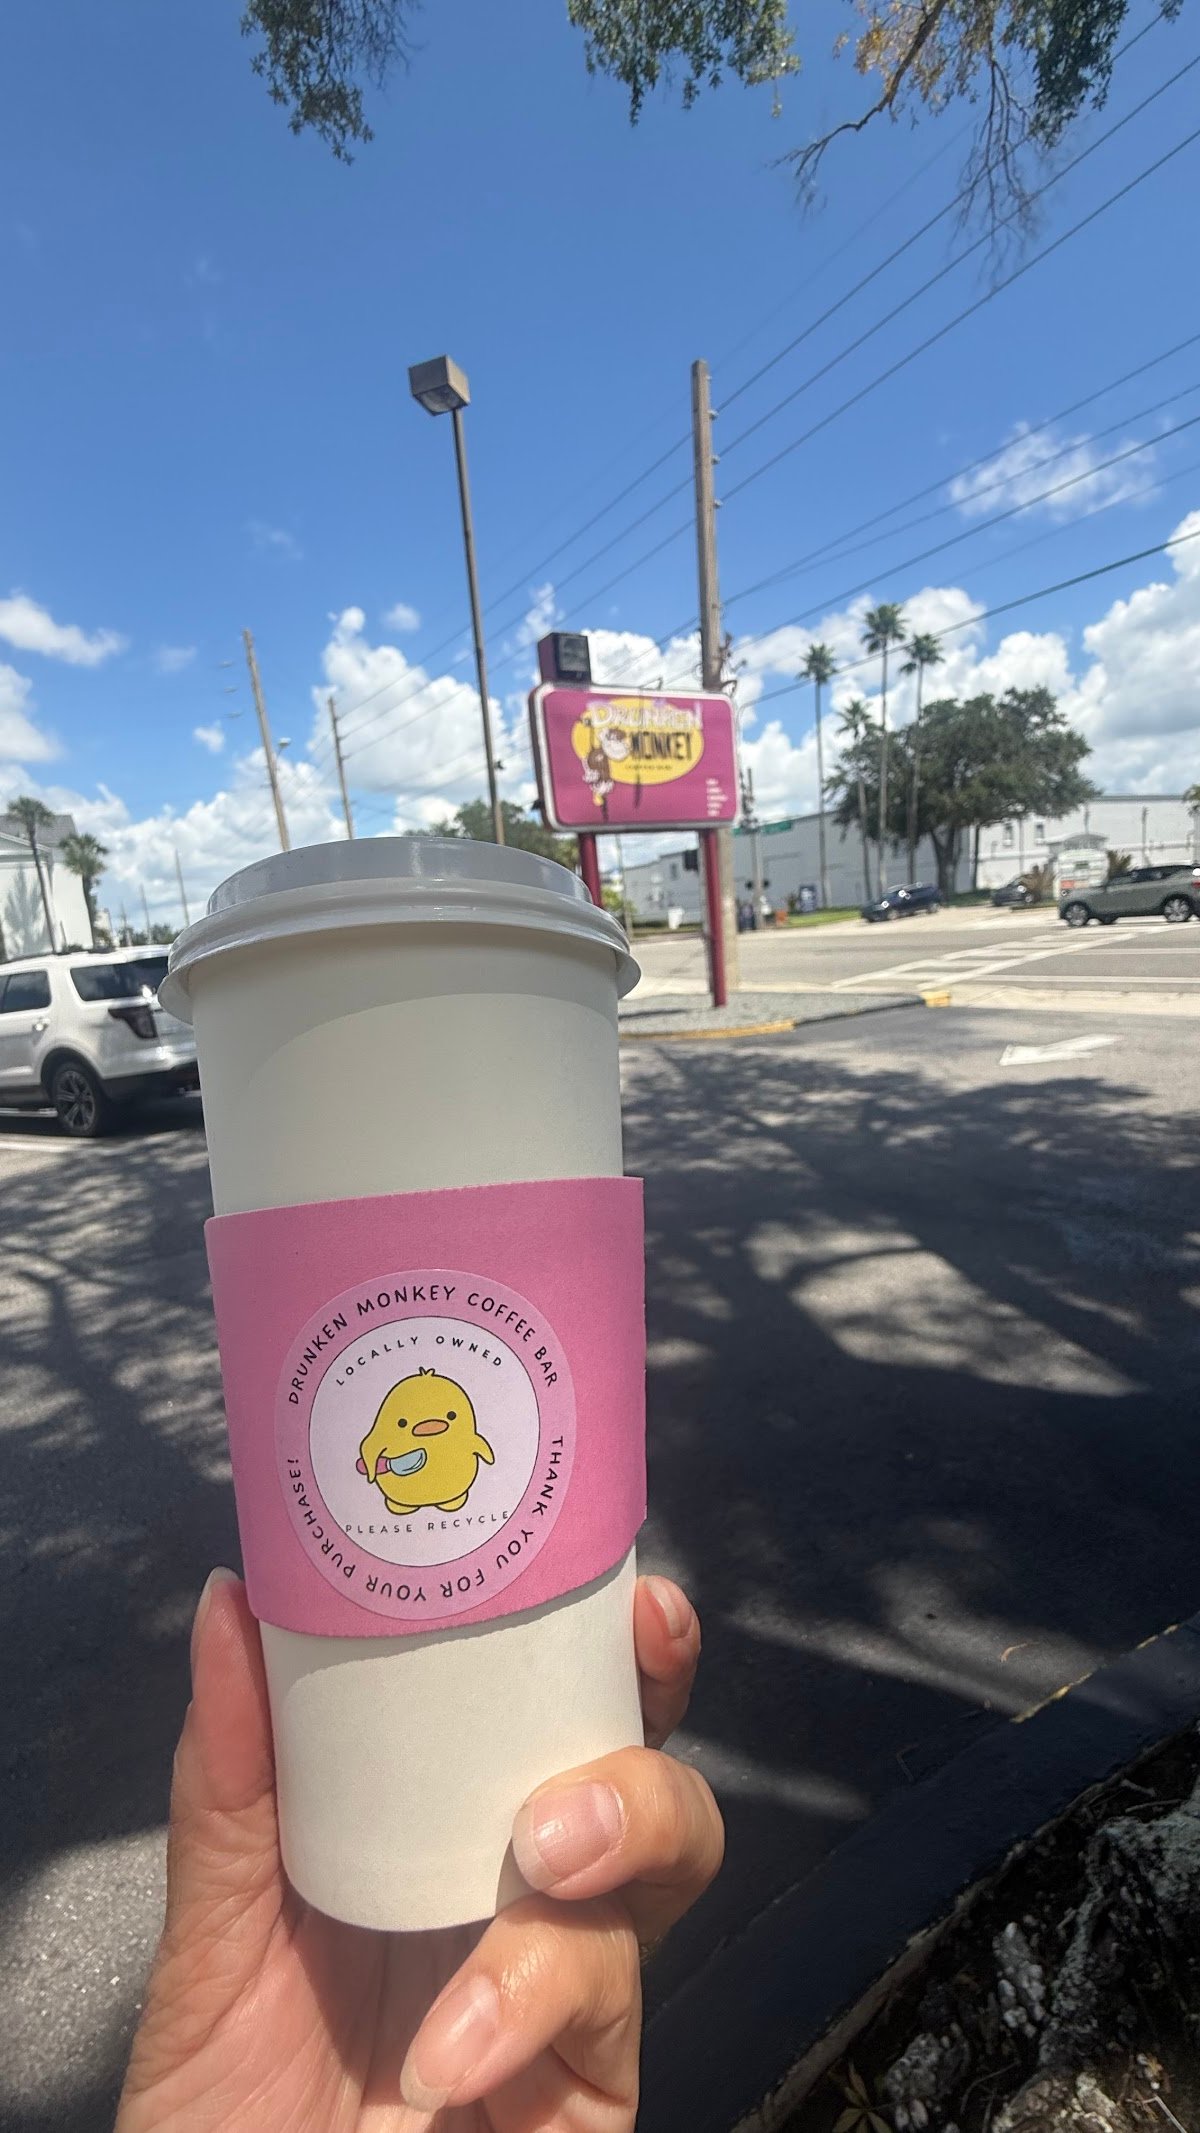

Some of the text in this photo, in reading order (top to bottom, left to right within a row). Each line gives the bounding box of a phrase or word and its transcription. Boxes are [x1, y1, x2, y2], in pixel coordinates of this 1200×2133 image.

[288, 1284, 558, 1405] DRUNKEN MONKEY COFFEE BAR
[336, 1335, 502, 1386] LOCALLY OWNED
[286, 1435, 563, 1602] THANK YOU FOR YOUR PURCHASE!
[345, 1510, 510, 1534] PLEASE RECYCLE
